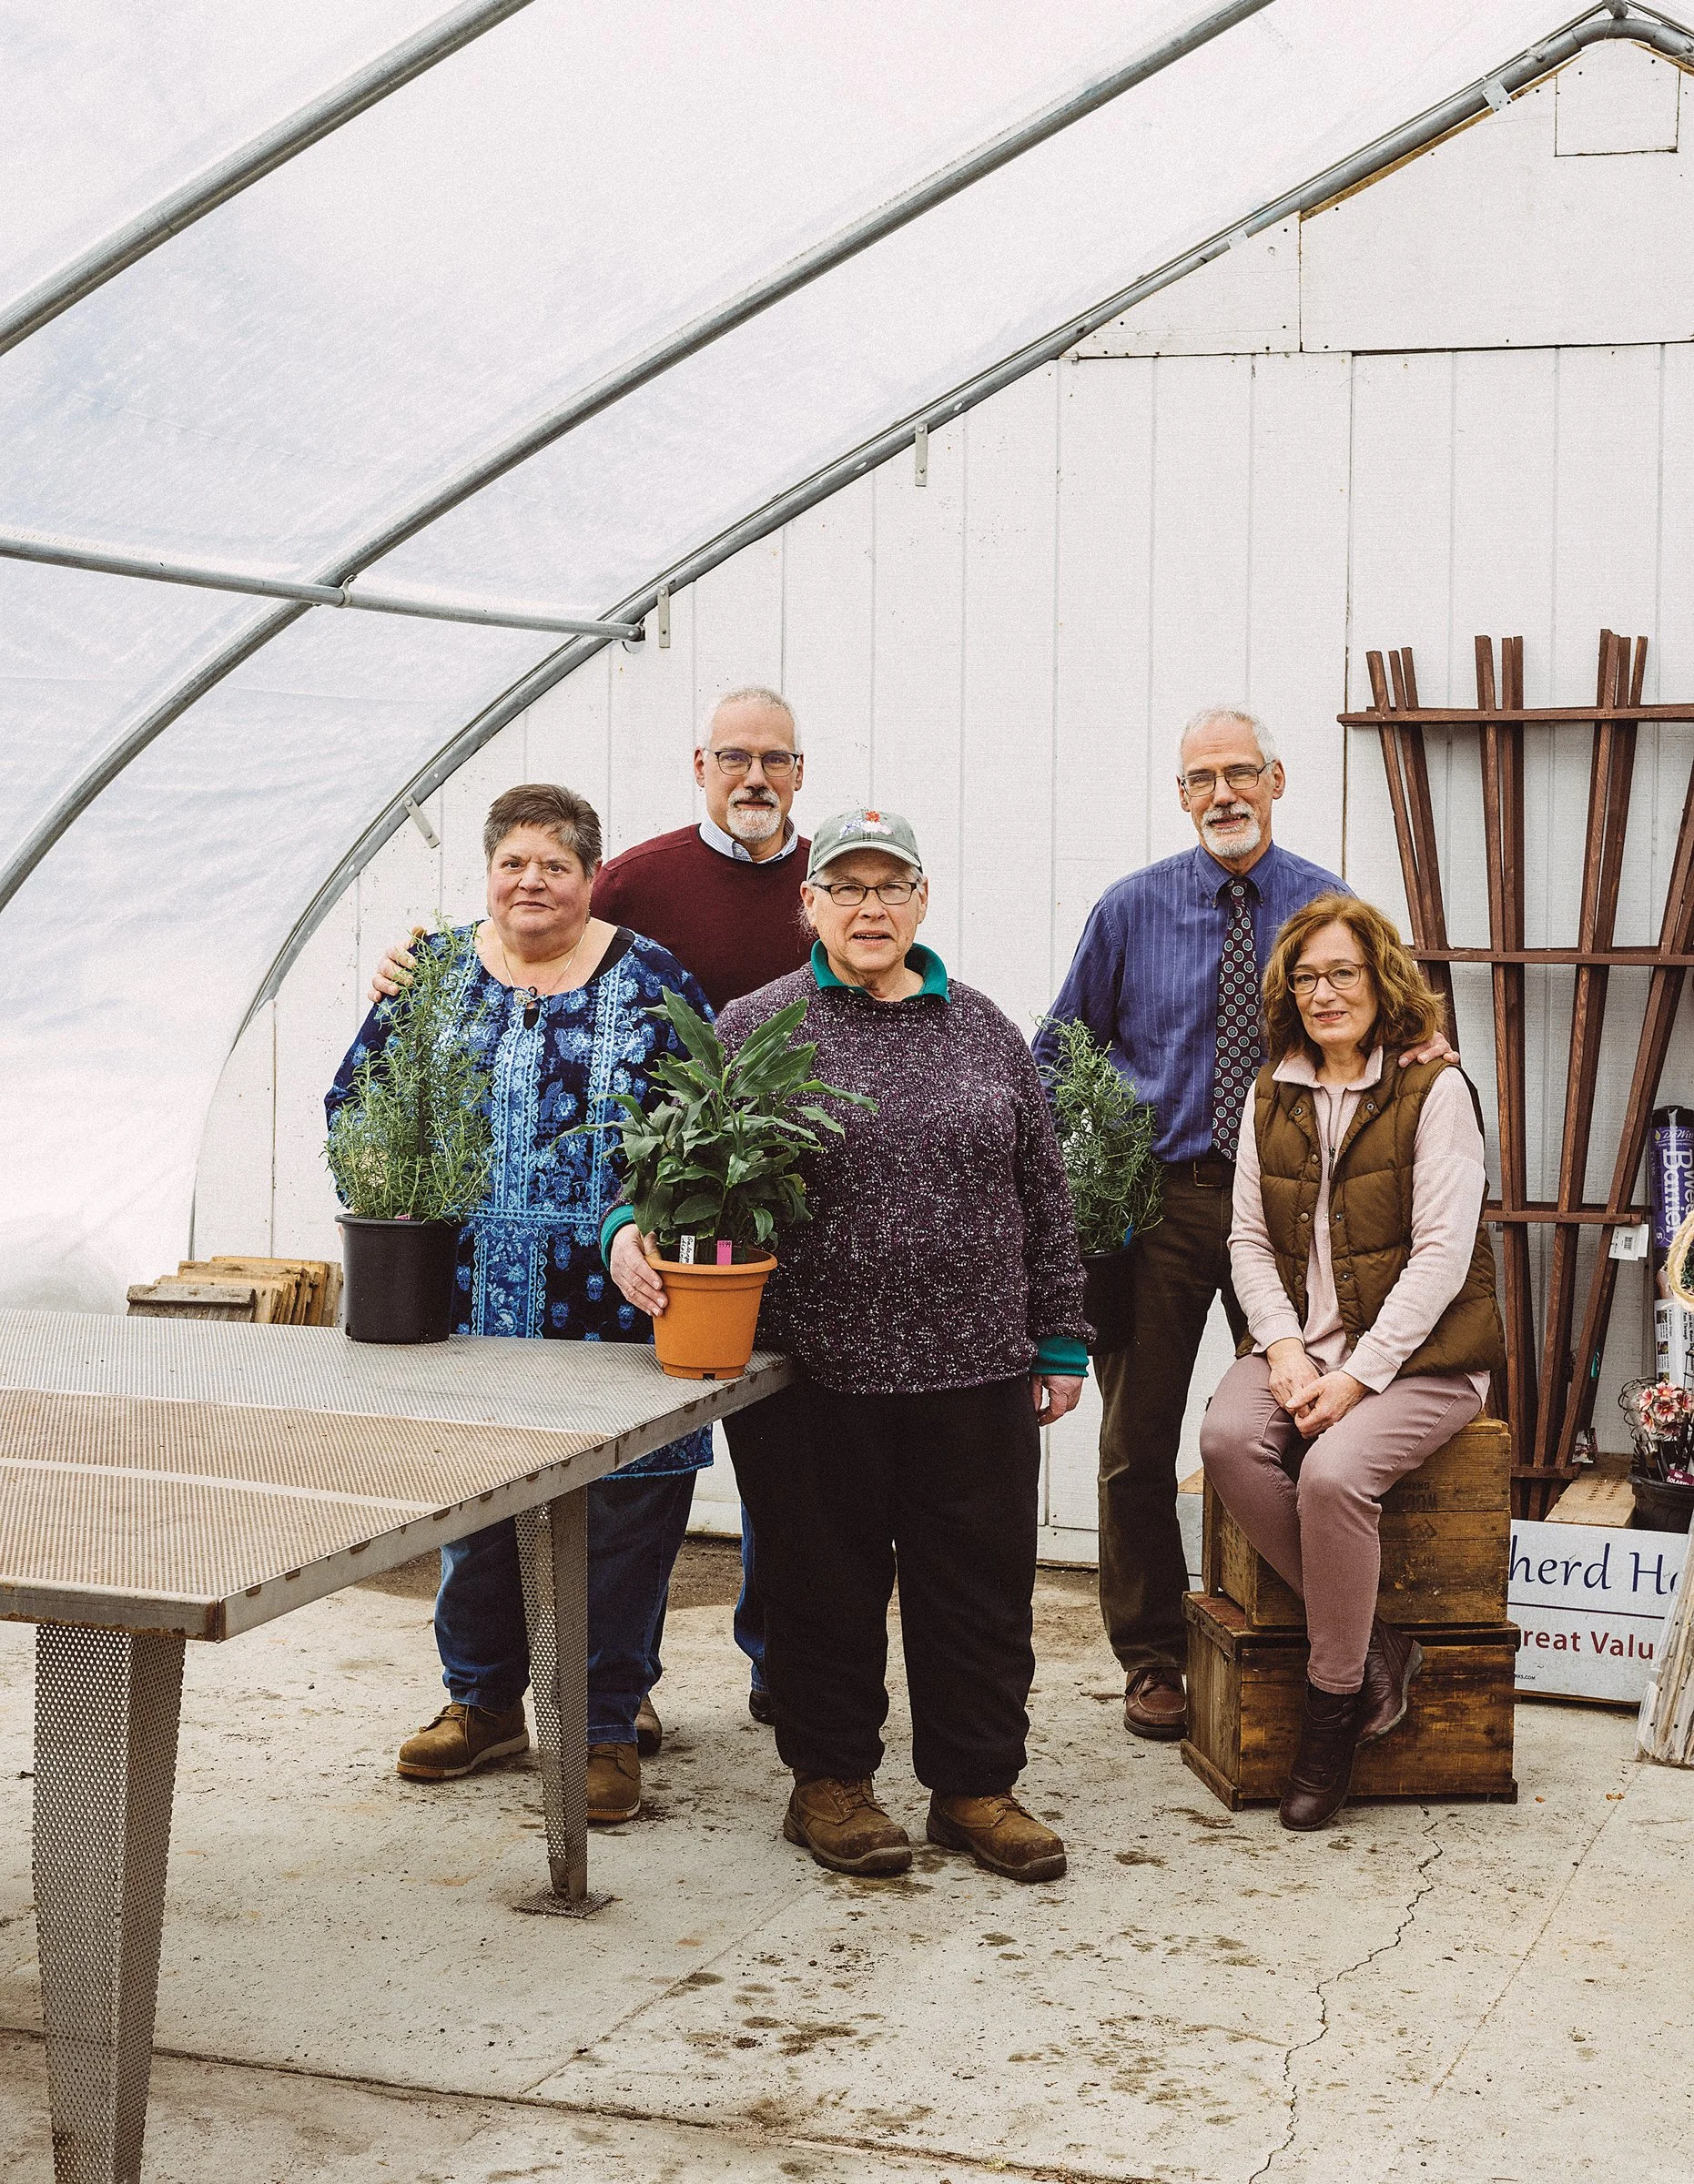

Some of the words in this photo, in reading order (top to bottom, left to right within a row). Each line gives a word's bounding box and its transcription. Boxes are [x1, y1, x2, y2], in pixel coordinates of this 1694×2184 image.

[1507, 1534, 1612, 1590] herd
[1522, 1629, 1581, 1653] reat
[1590, 1631, 1654, 1660] Valu
